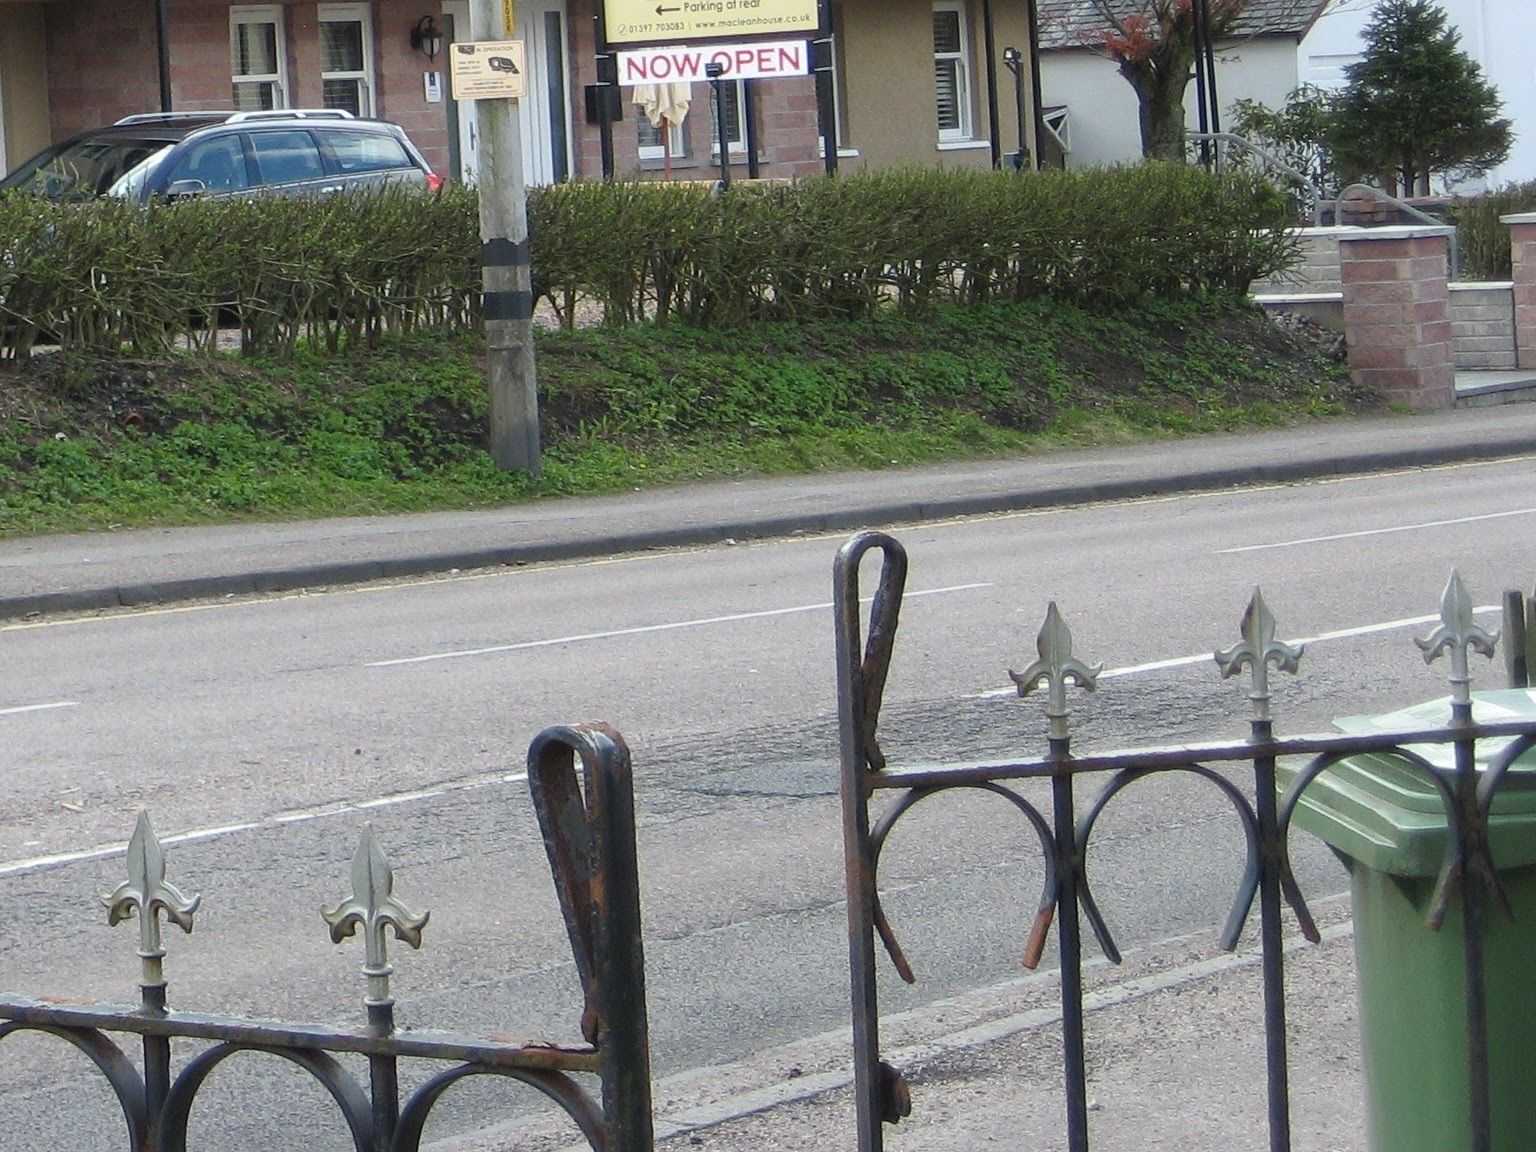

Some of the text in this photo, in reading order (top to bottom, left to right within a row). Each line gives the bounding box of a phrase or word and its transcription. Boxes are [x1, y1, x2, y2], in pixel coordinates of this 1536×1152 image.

[683, 0, 761, 14] Parking at rear
[628, 13, 811, 33] 01397 703083 www.macleanhouse.co.uk
[626, 47, 800, 80] NOW OPEN
